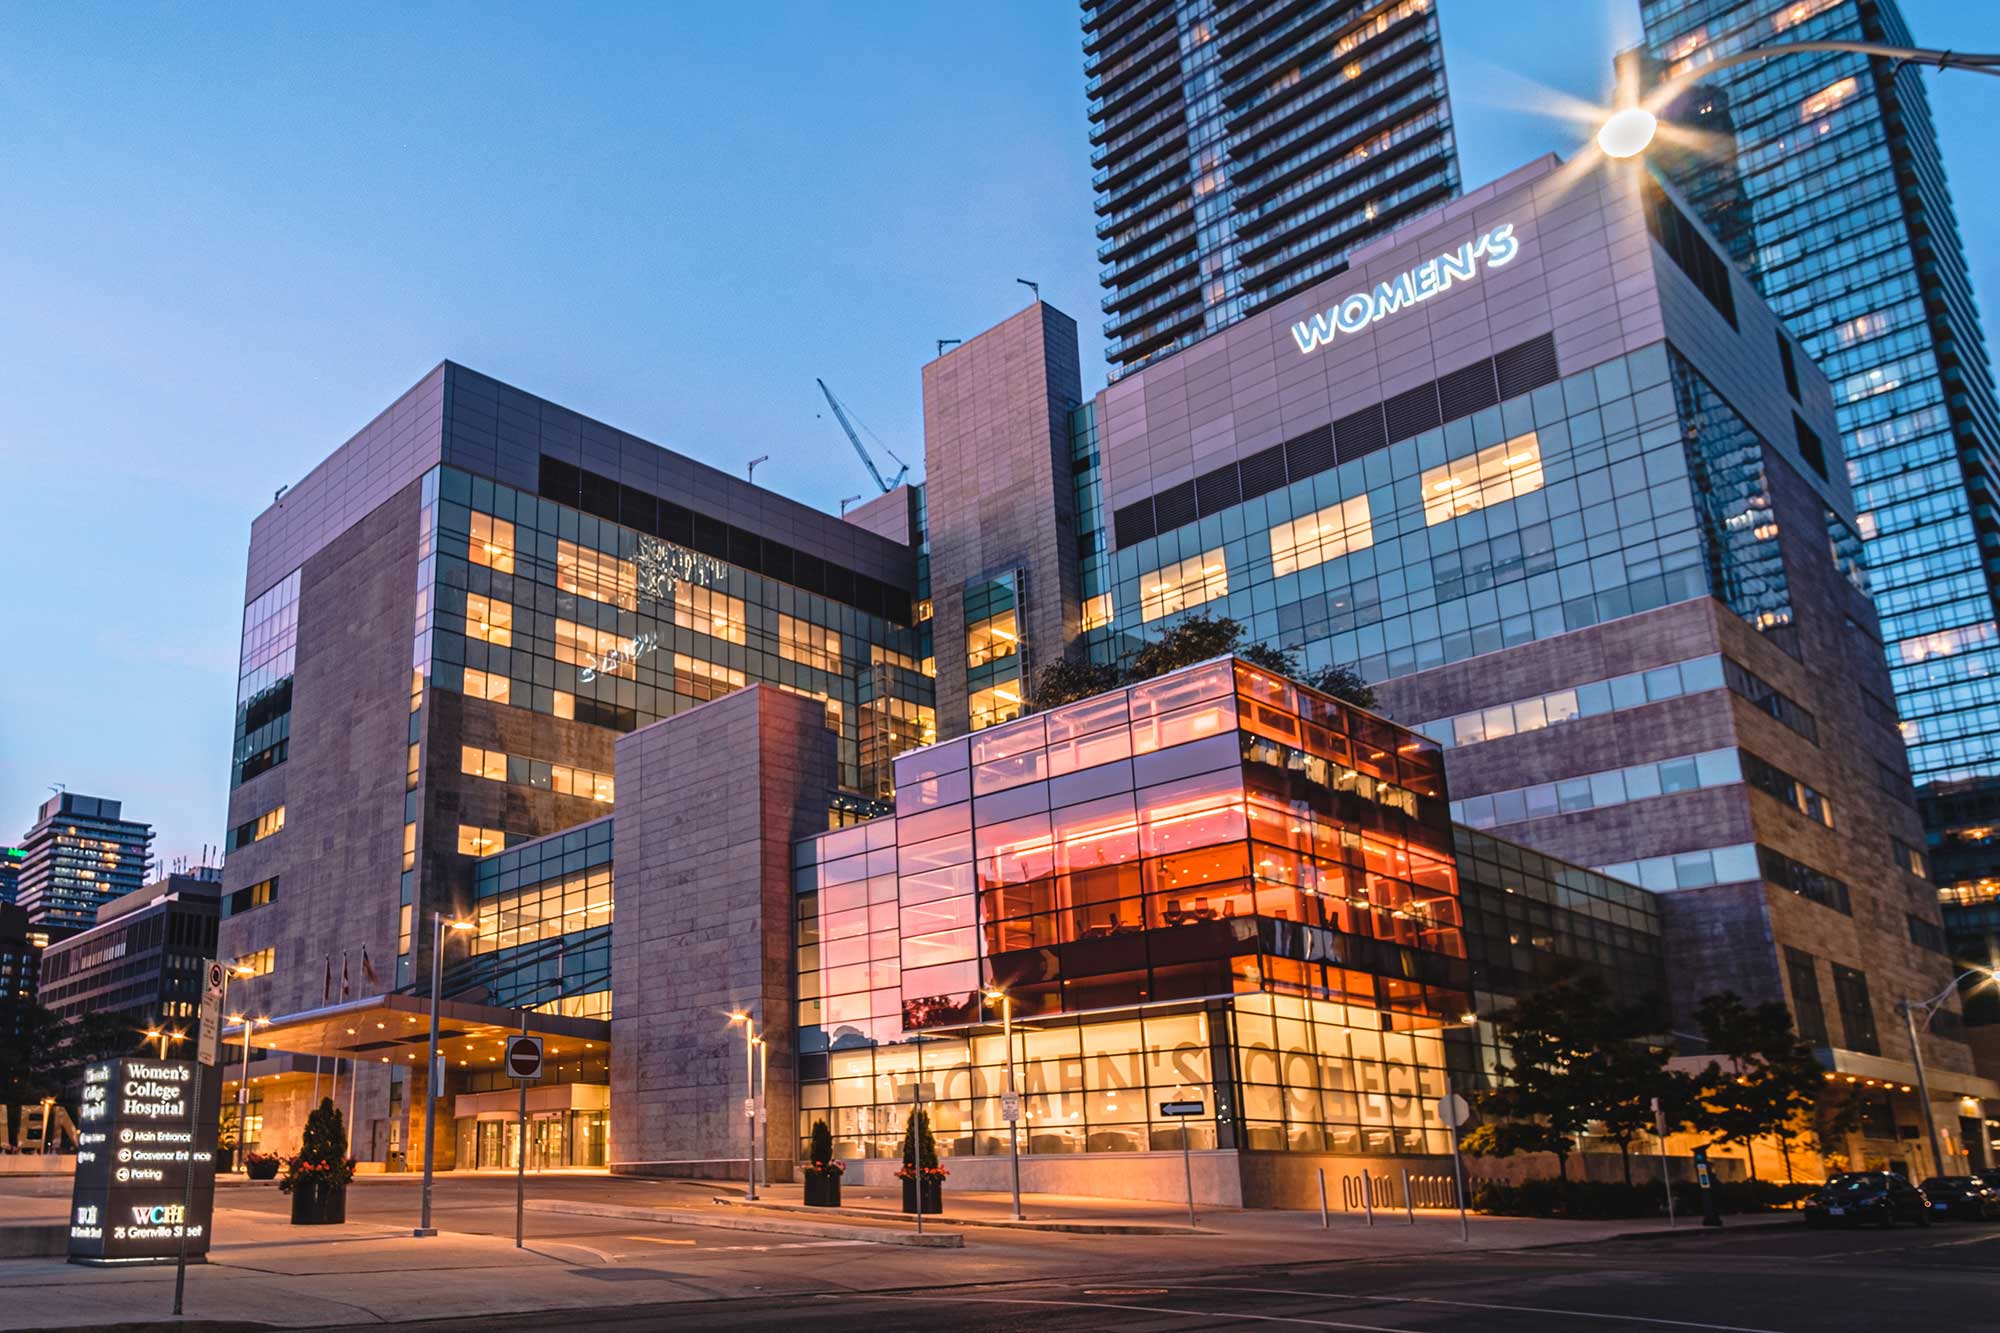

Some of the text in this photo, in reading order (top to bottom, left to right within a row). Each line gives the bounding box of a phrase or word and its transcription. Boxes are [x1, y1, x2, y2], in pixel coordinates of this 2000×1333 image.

[1291, 223, 1519, 354] WOMEN'S
[127, 1063, 190, 1081] Women's
[1244, 1041, 1434, 1121] COLLEGE
[125, 1081, 180, 1100] College
[123, 1099, 184, 1118] Hospital
[134, 1131, 156, 1142] Main
[133, 1150, 175, 1161] Grosvenor
[131, 1168, 162, 1181] Parking
[114, 1227, 126, 1239] 76
[127, 1226, 172, 1239] Grenville
